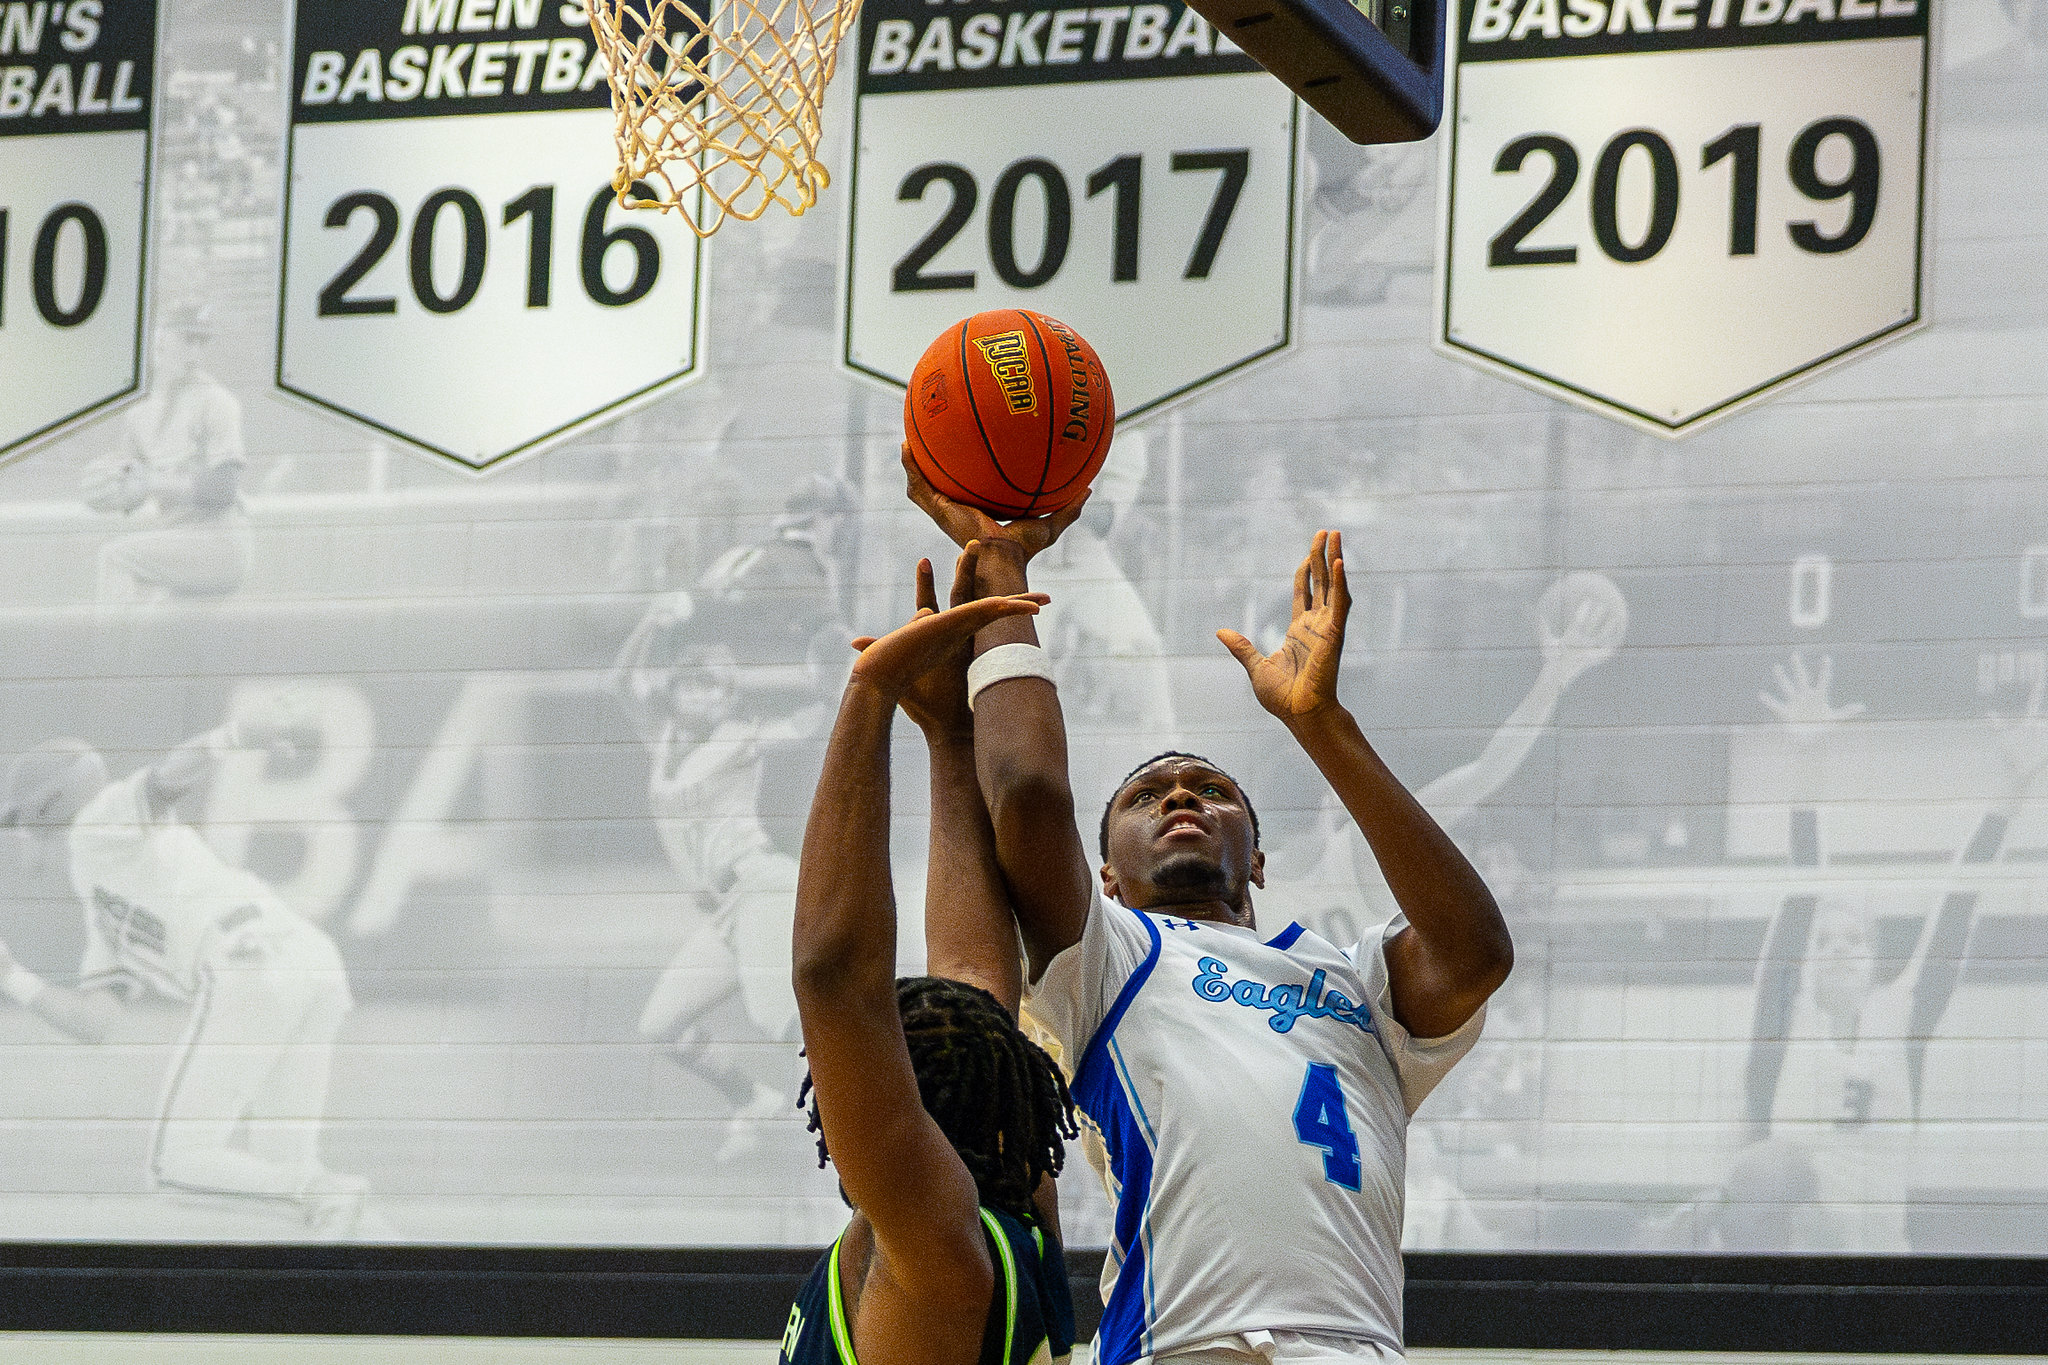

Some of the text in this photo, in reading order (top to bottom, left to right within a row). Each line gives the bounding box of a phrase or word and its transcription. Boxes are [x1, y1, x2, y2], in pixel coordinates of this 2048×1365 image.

[0, 0, 104, 55] N'S
[401, 0, 592, 35] MEN
[868, 4, 1245, 75] BASKETBA
[1467, 0, 1919, 43] BASKEB
[891, 148, 1251, 292] 2017
[1487, 115, 1881, 267] 2019
[317, 181, 662, 317] 2016
[974, 330, 1037, 415] NJCAA
[1192, 956, 1377, 1034] Eagles
[1292, 1061, 1361, 1193] 4
